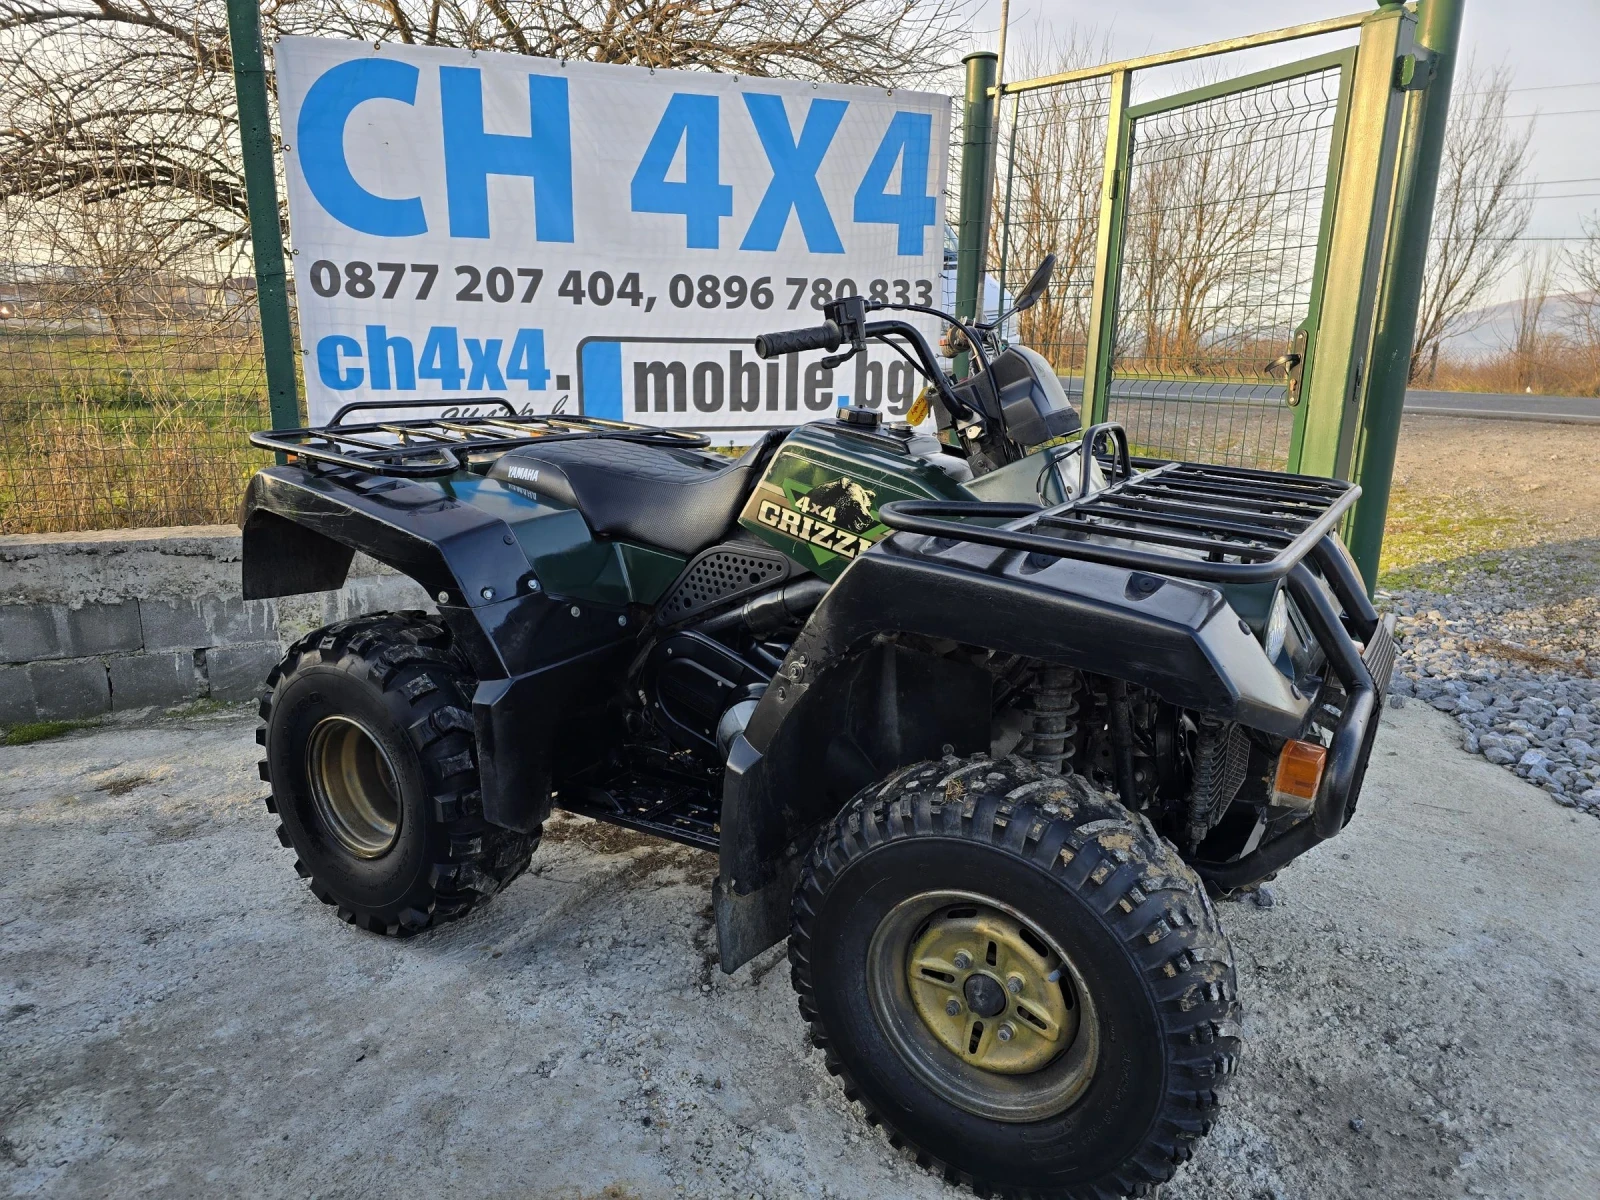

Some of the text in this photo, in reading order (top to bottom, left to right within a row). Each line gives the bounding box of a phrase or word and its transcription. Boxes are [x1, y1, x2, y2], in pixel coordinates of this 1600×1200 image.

[297, 58, 936, 256] CH 4X4
[310, 259, 933, 313] 0877 207 404, 0896 780 833
[633, 350, 915, 416] mobile.bg
[508, 465, 539, 482] YAMAHA
